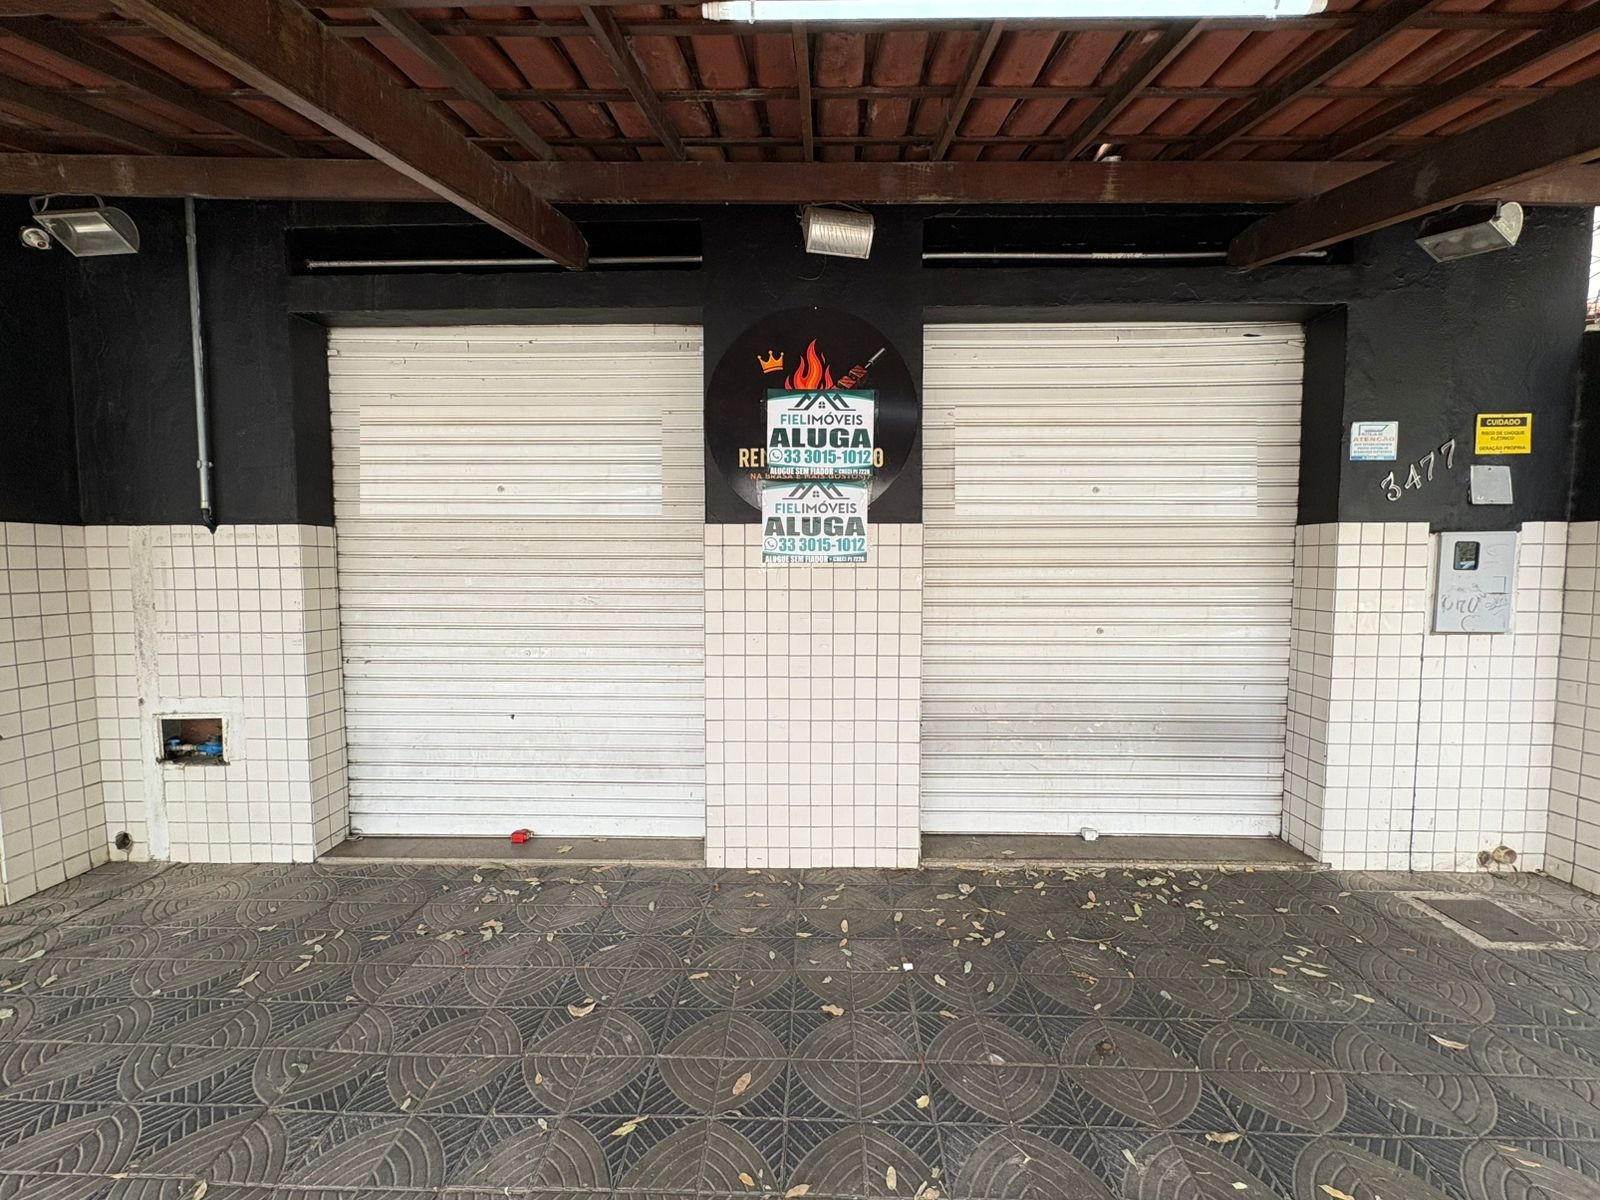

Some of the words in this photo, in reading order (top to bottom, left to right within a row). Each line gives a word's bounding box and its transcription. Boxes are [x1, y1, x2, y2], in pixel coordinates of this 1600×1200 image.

[780, 412, 863, 426] FIELIMÓVEIS
[1486, 418, 1521, 426] CUIDADO
[769, 428, 871, 448] ALUGA
[784, 449, 800, 464] 33
[804, 449, 872, 464] 3015-1012
[770, 467, 794, 475] ALUGUE
[796, 467, 809, 475] SEM
[810, 467, 834, 475] FIADOR
[1380, 438, 1456, 502] 3477
[774, 500, 857, 514] FIELIMÓVEIS
[764, 517, 866, 537] ALUGA
[779, 538, 795, 552] 33
[799, 537, 865, 552] 3015-1012
[765, 555, 789, 563] ALUGUE
[791, 555, 804, 563] SEM
[805, 555, 829, 563] FIADOR
